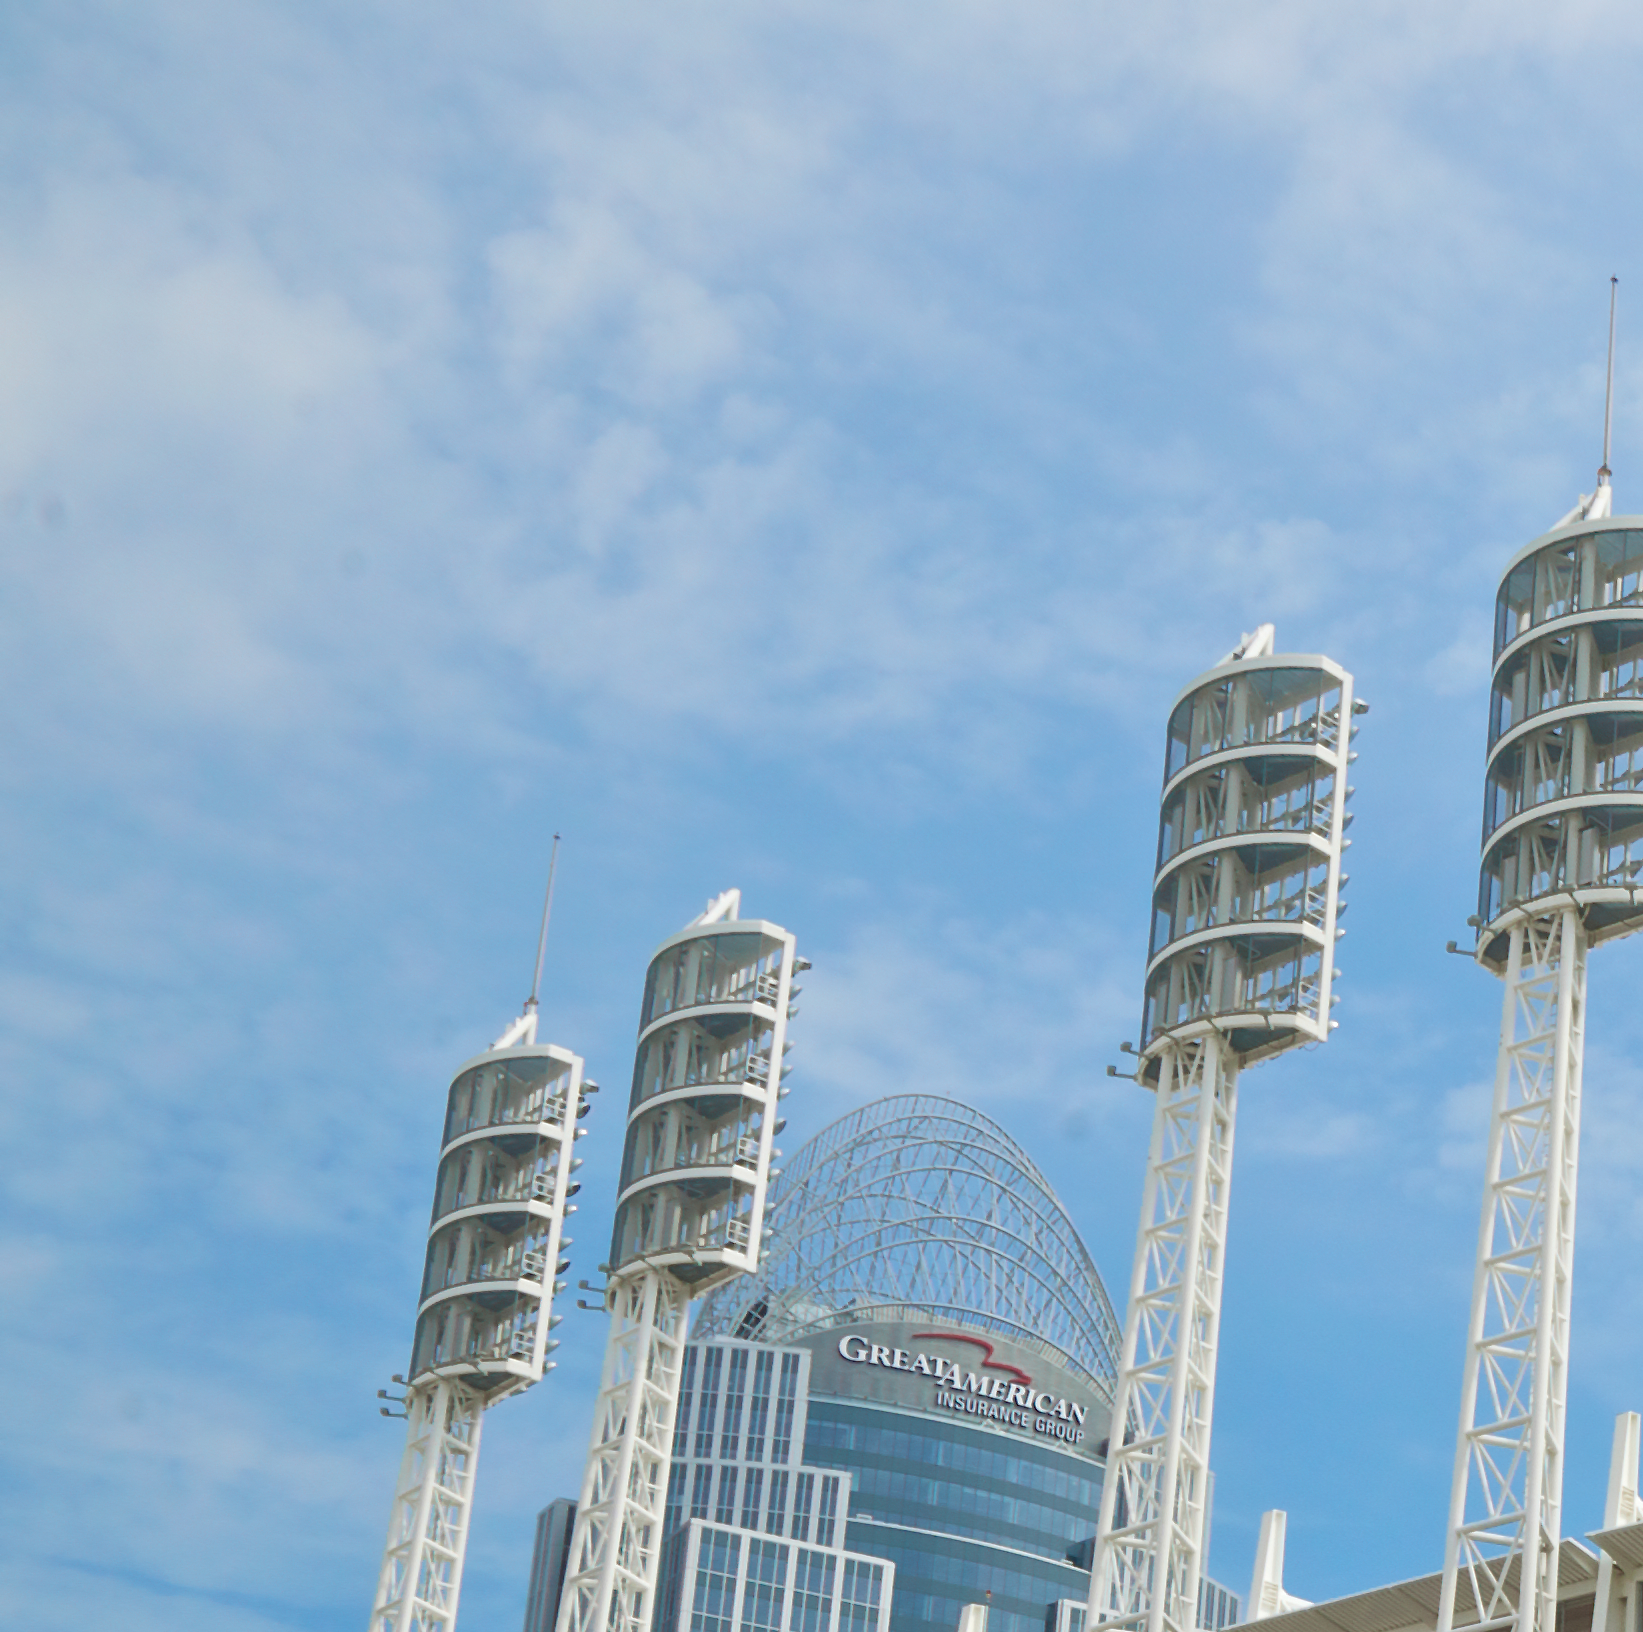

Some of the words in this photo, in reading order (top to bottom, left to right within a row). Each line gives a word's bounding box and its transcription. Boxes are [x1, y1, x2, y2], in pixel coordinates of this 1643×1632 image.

[838, 1334, 950, 1378] GREAT
[935, 1363, 1089, 1425] AMERICAN
[936, 1391, 1029, 1428] INSURANCE
[1034, 1418, 1085, 1444] GROUP
